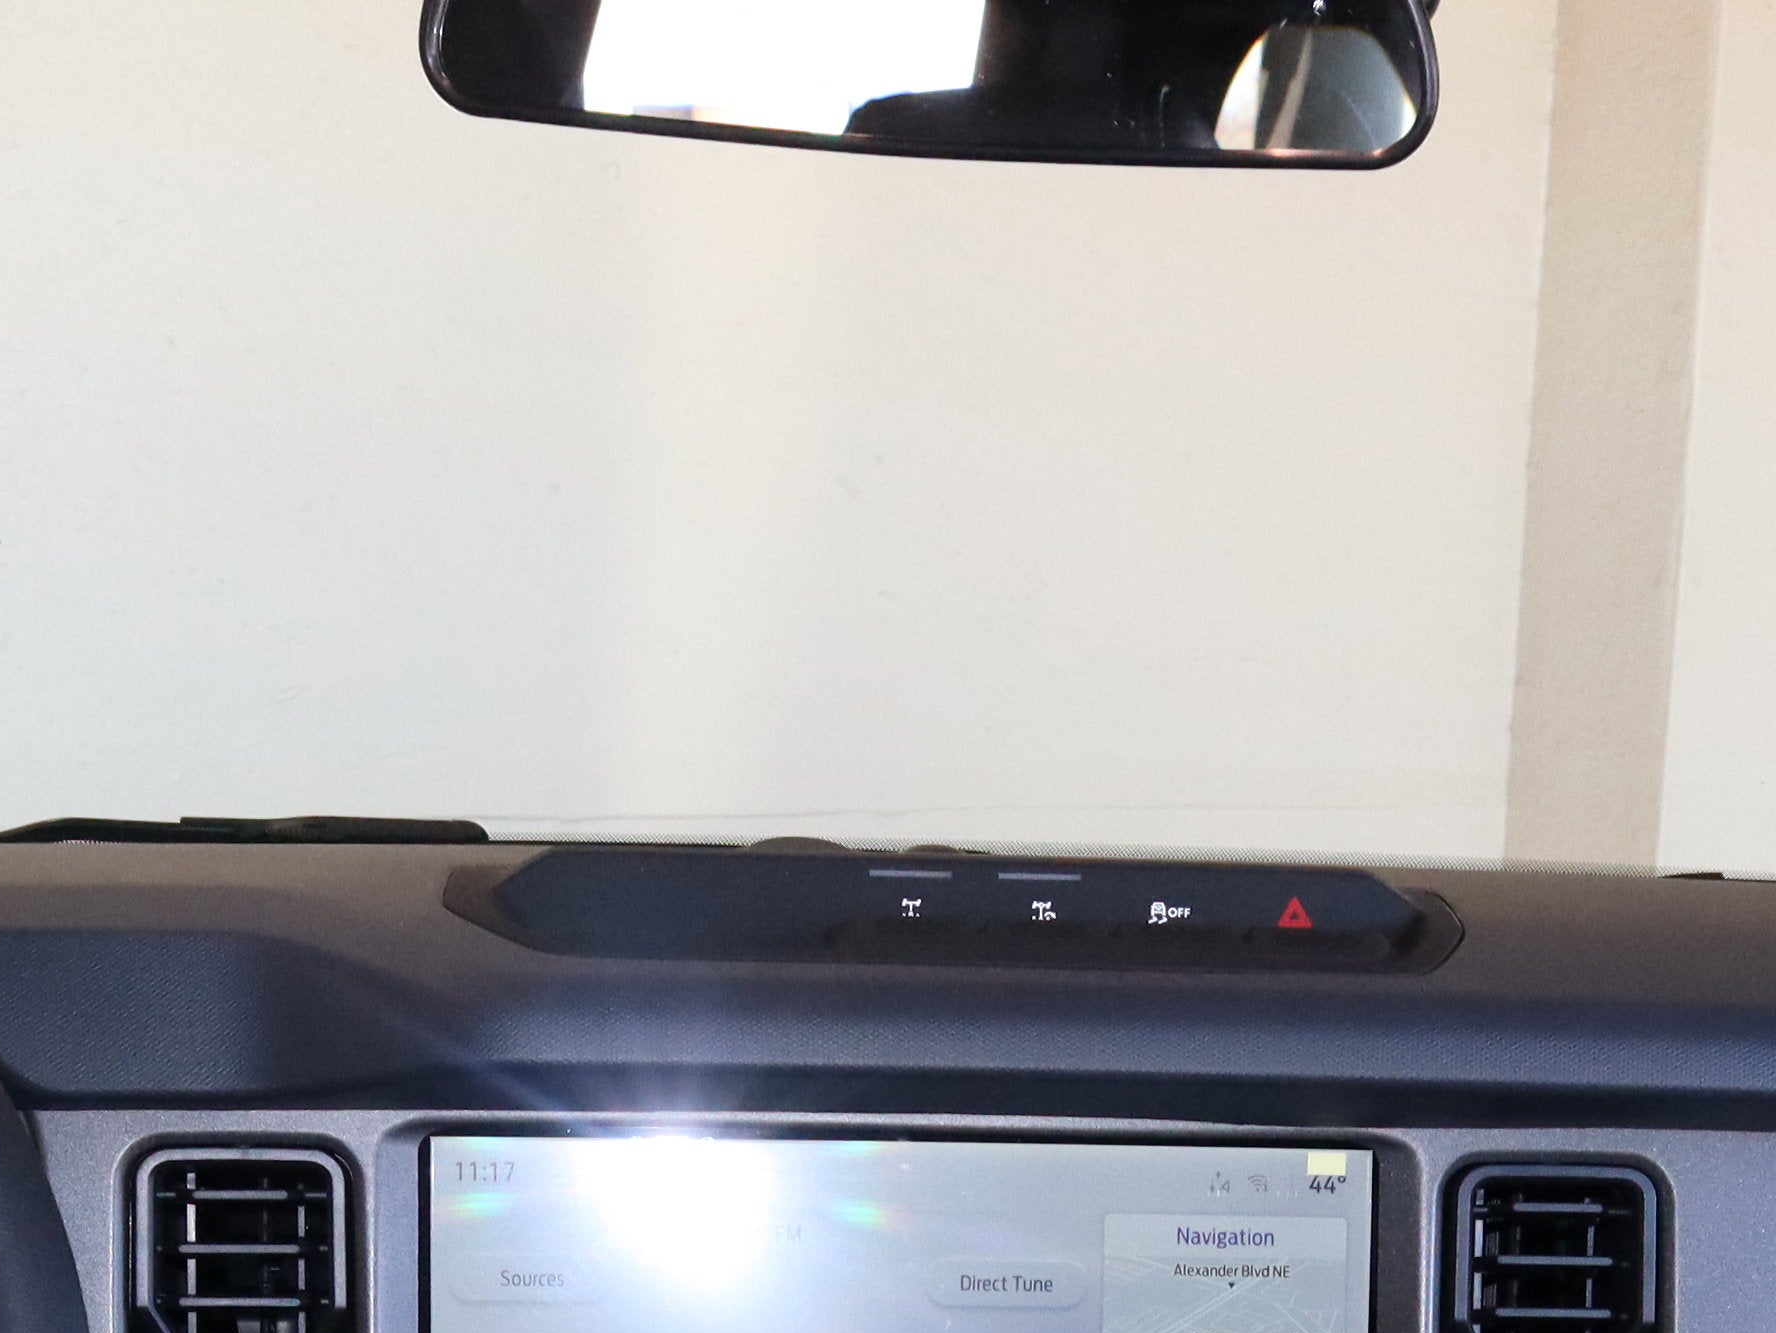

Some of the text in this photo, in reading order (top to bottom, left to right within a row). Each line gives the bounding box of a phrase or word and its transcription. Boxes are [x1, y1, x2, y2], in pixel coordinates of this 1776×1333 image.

[1168, 907, 1191, 918] OFF
[454, 1160, 516, 1182] 11:17
[1176, 1226, 1275, 1250] Navigation
[500, 1269, 565, 1290] Sources
[1174, 1264, 1291, 1278] Alexander Blvd NE
[960, 1274, 1054, 1293] Direct Tune
